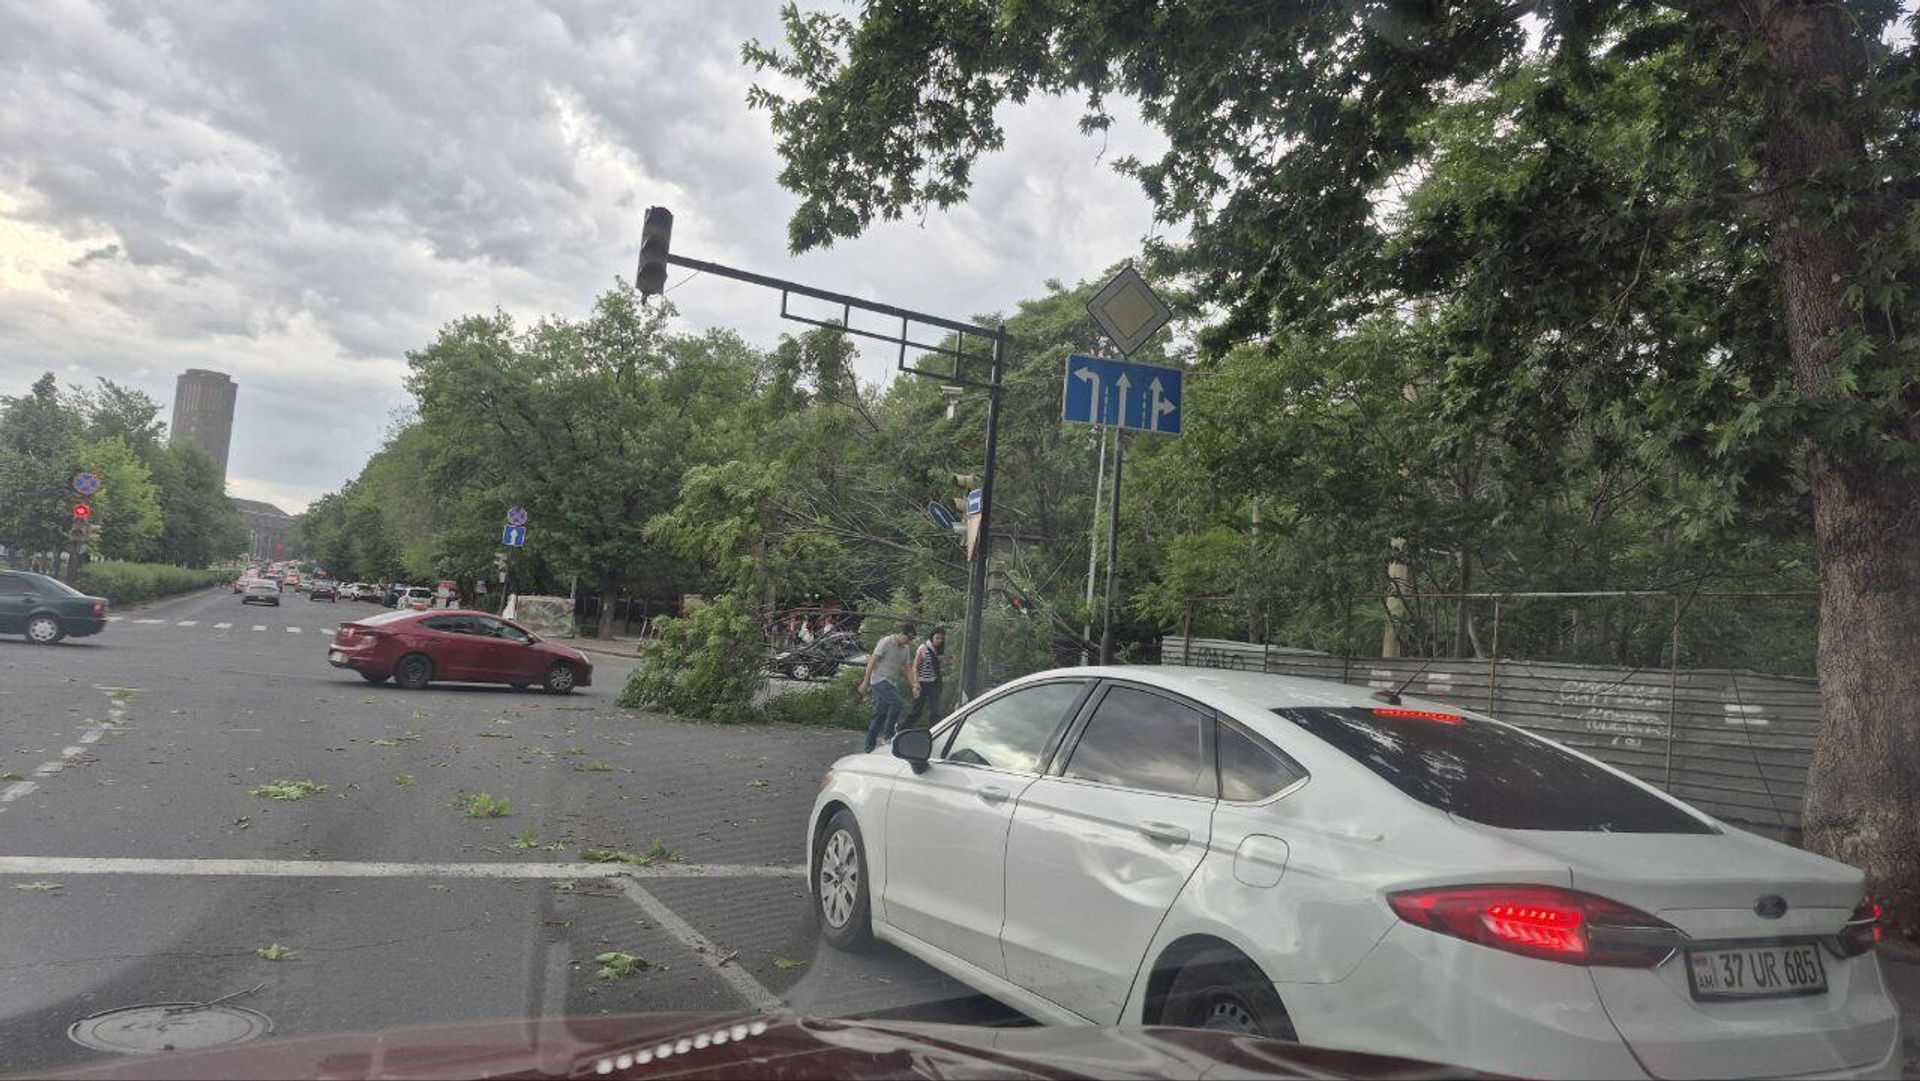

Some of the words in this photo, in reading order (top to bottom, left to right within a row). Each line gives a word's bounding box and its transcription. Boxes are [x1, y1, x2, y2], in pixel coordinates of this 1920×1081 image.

[1699, 974, 1714, 988] AM
[1719, 954, 1744, 988] 37
[1749, 951, 1781, 988] UR
[1784, 950, 1818, 986] 685
